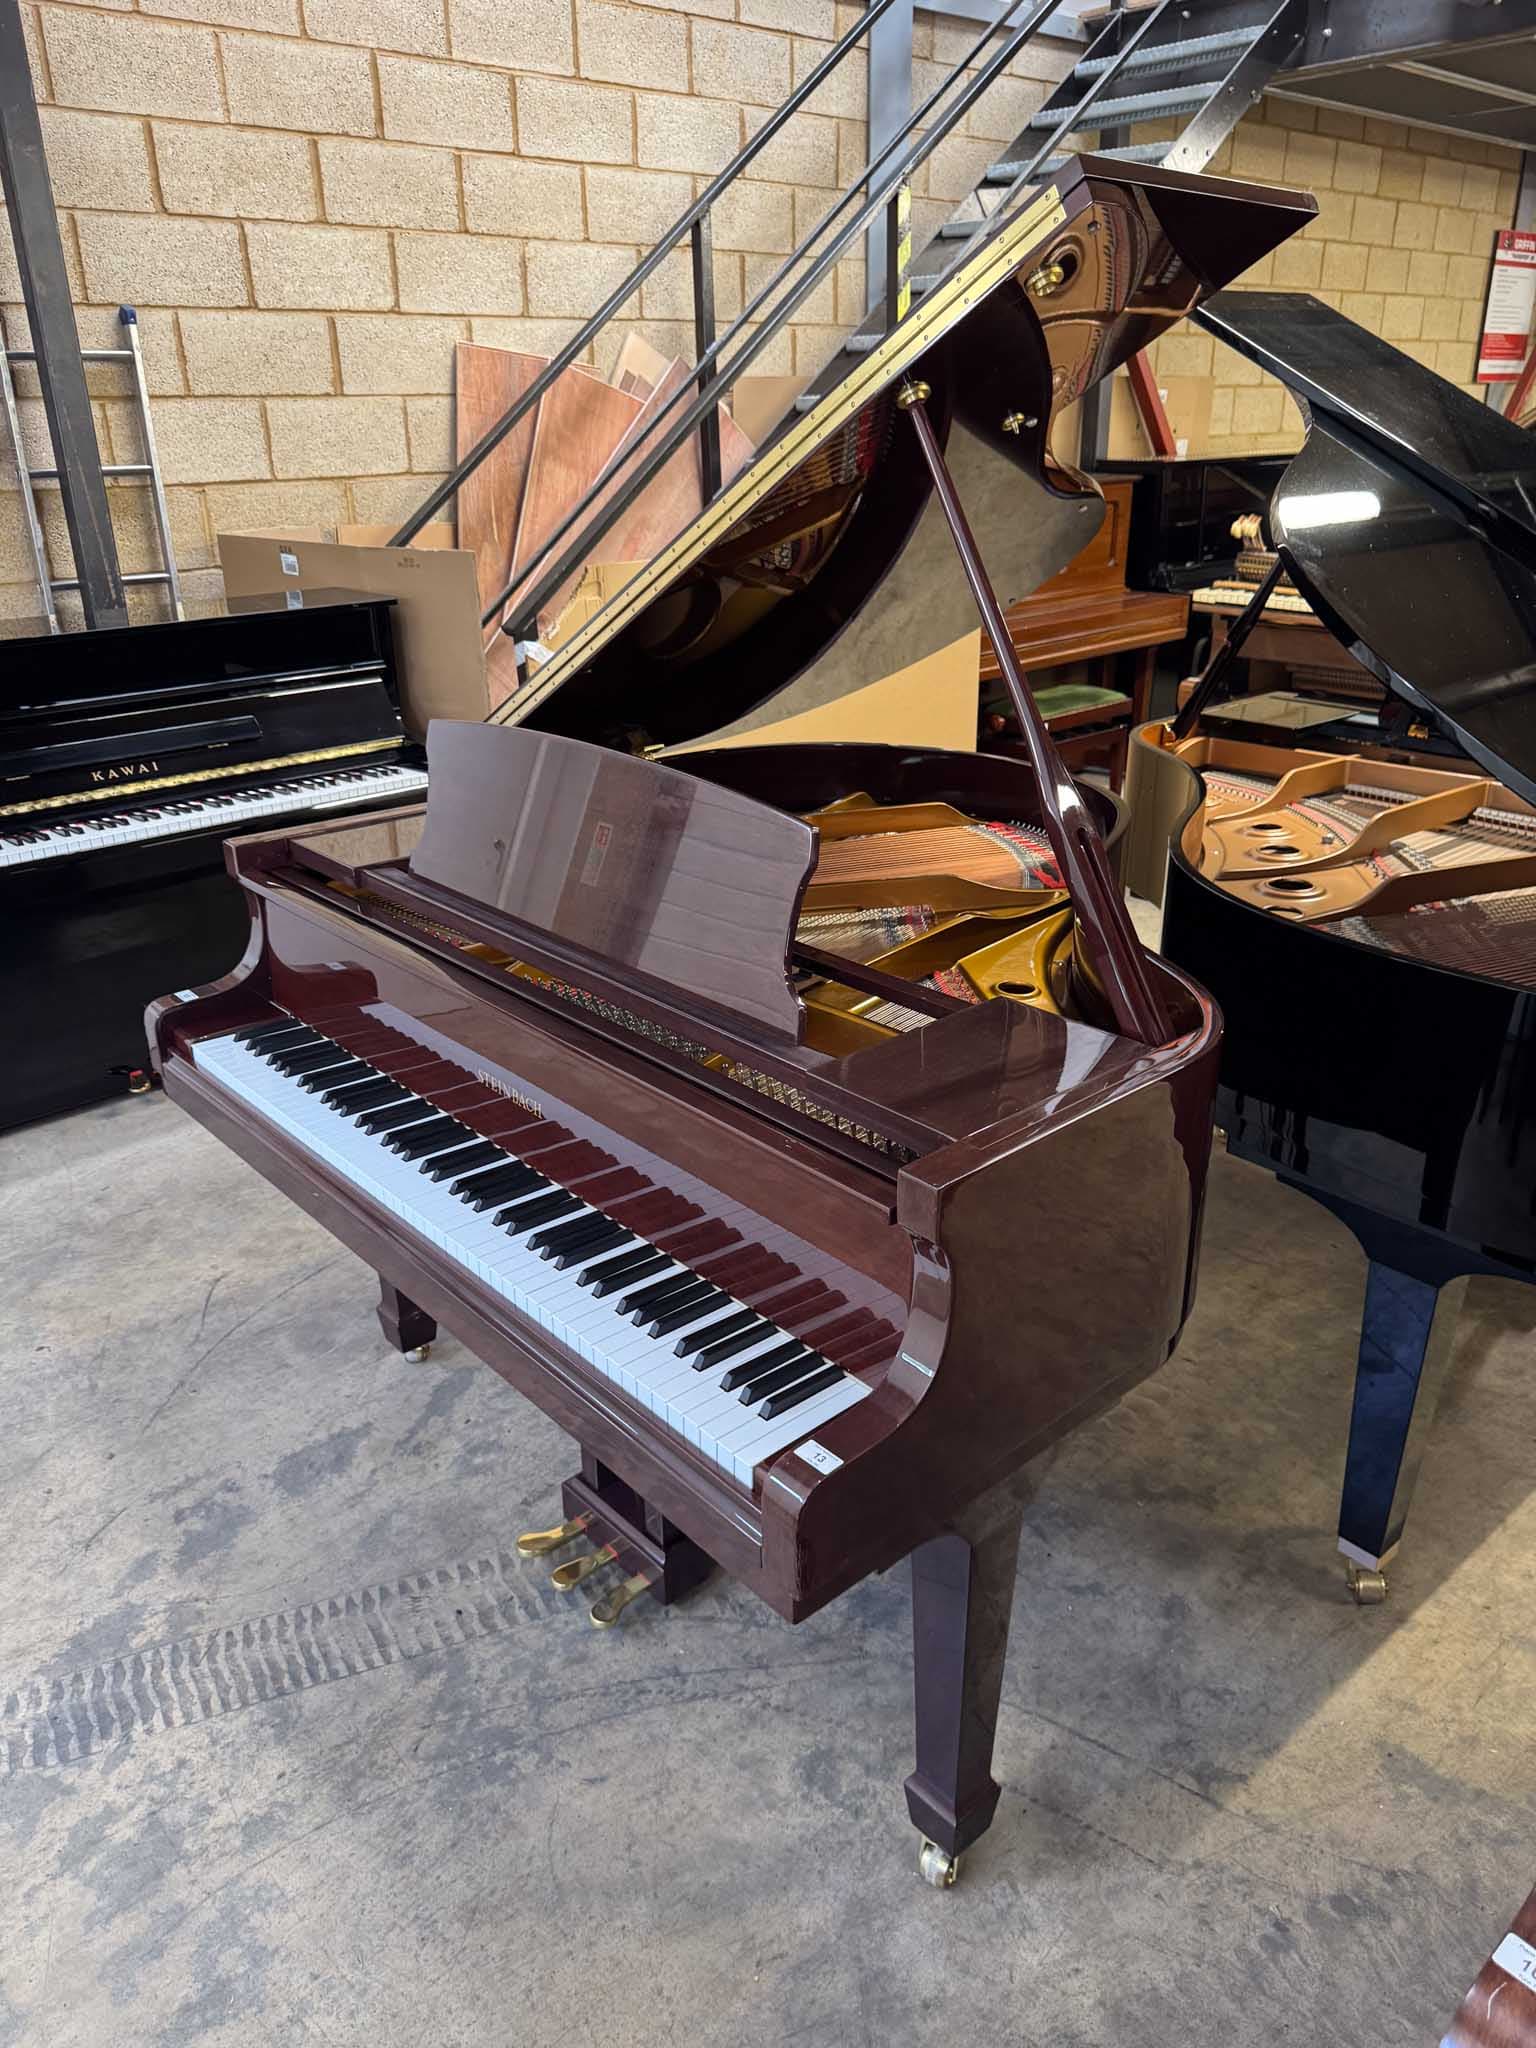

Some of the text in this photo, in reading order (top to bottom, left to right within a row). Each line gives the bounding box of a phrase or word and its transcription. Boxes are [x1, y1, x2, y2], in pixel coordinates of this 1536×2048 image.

[90, 761, 160, 782] KAWAI
[478, 1069, 543, 1119] STEINBACH
[813, 1452, 827, 1463] 13
